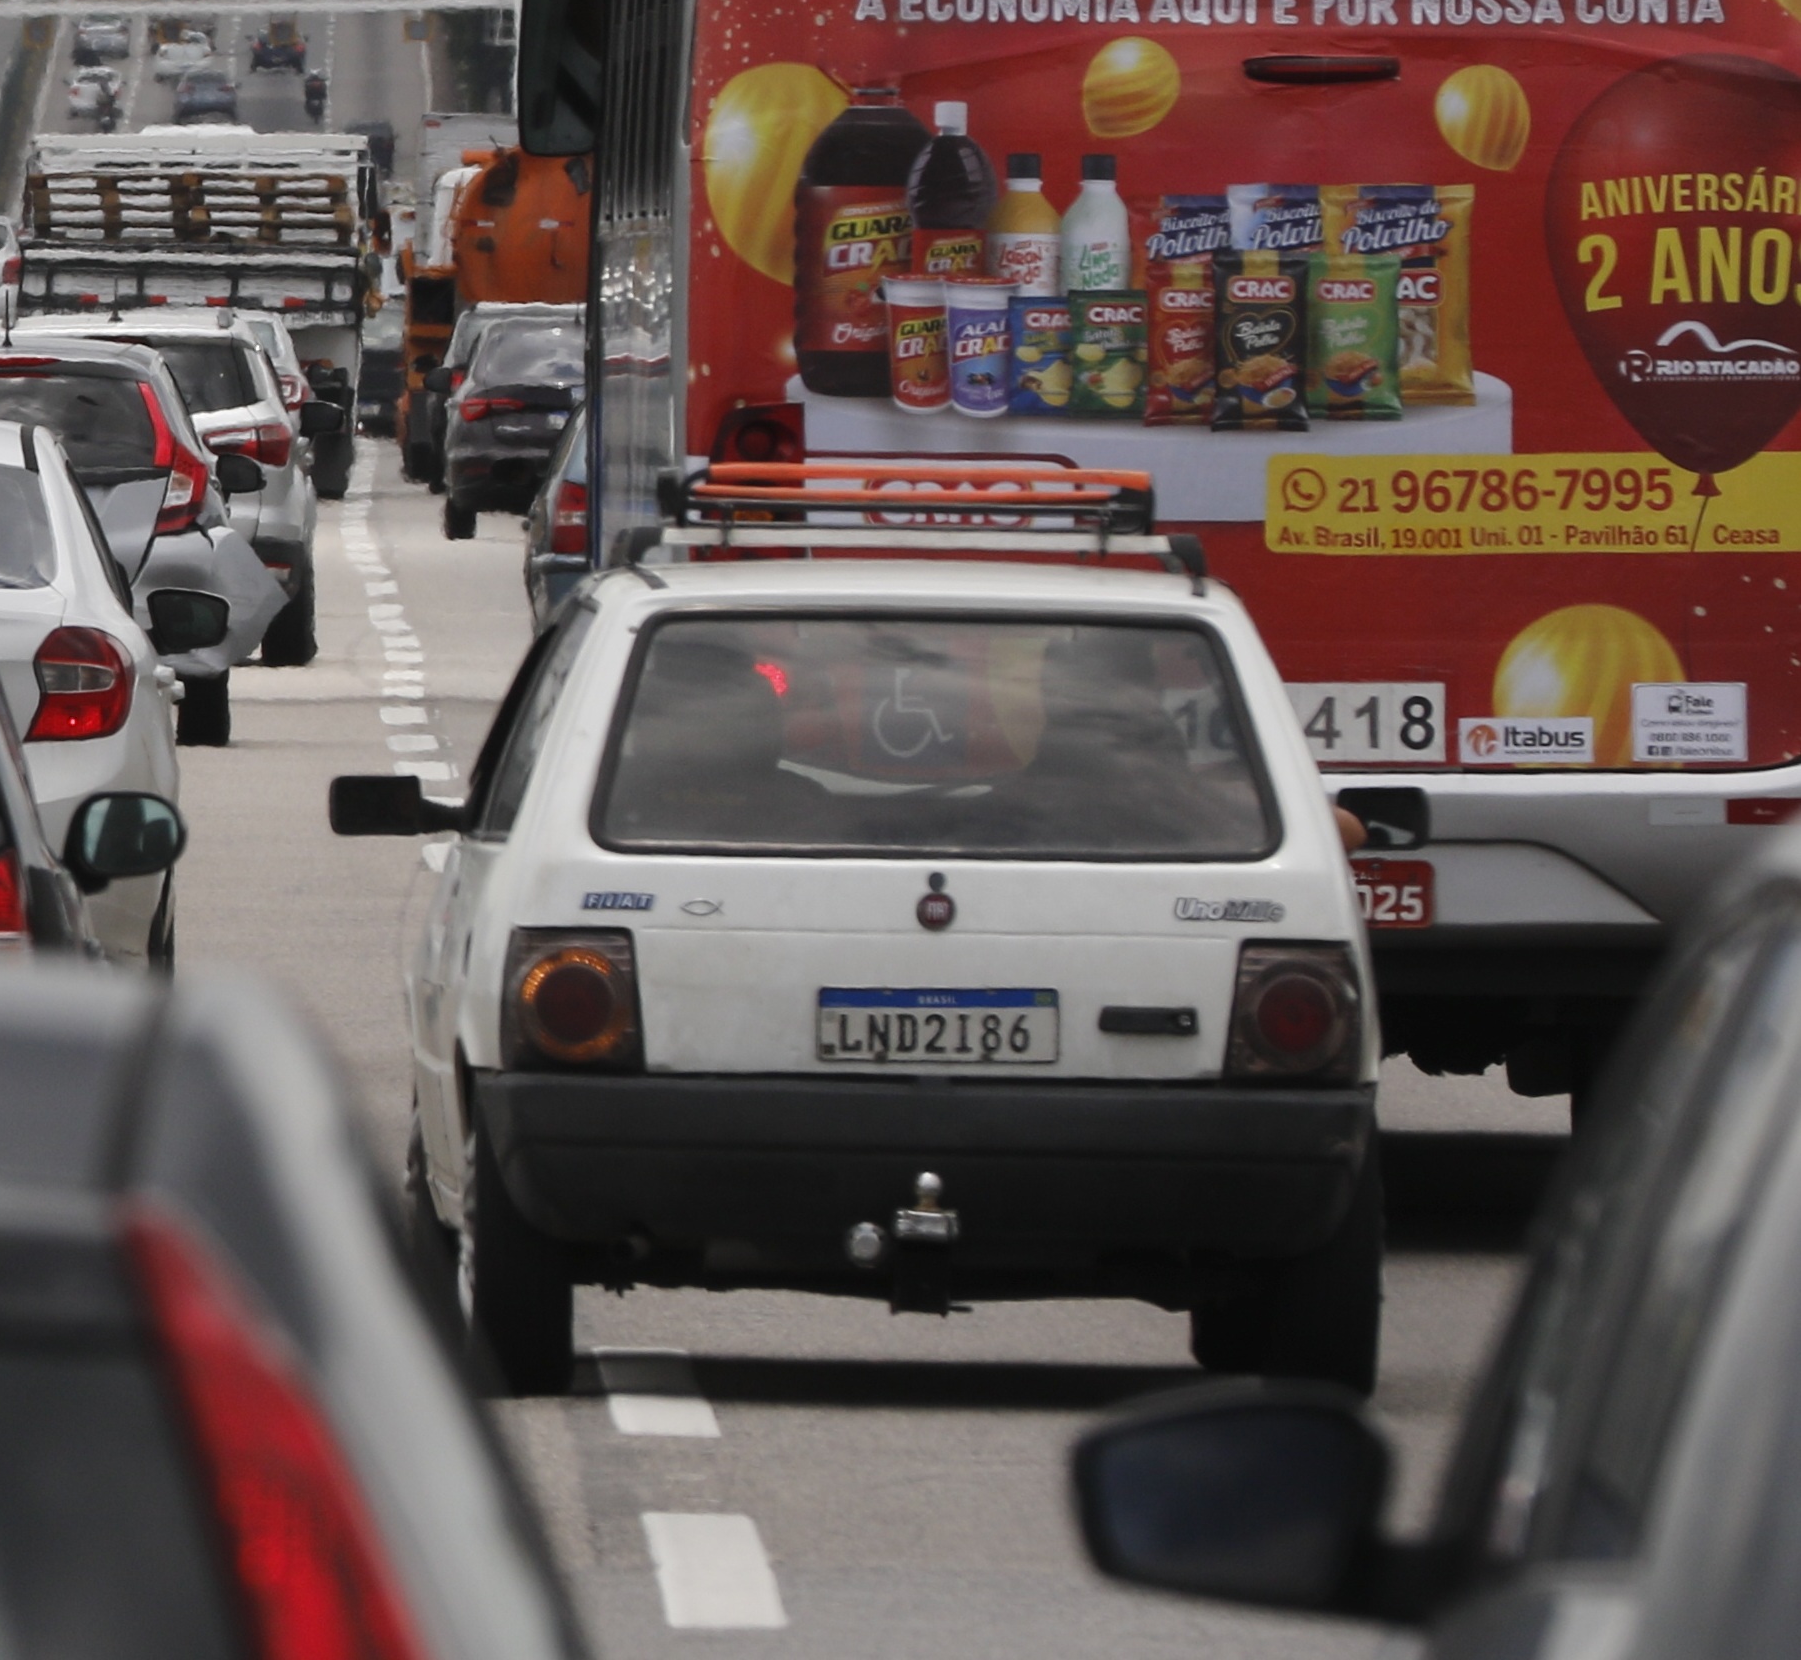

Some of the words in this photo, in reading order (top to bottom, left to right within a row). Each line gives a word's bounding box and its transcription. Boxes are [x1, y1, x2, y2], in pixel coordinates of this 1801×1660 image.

[1581, 167, 1801, 221] ANIVERSÁR
[1356, 204, 1418, 226] Biscoito
[1342, 214, 1453, 254] Polvilho
[1578, 234, 1623, 312] 2
[1650, 227, 1801, 306] ANO
[1164, 292, 1213, 308] CRAC
[1232, 280, 1290, 299] CRAC
[1319, 282, 1373, 300] CRAC
[1088, 307, 1144, 324] CRAC
[955, 336, 1009, 357] CRAC
[1338, 478, 1380, 513] 21
[1391, 468, 1674, 513] 96786-7995
[1277, 527, 1311, 547] Av.
[1315, 525, 1386, 550] Brasil,
[1391, 528, 1463, 549] 19.001
[1470, 526, 1513, 547] Uni.
[1517, 526, 1544, 546] 01
[1564, 524, 1659, 547] Pavilhão
[1663, 526, 1689, 546] 61
[1712, 525, 1780, 546] Ceasa
[1305, 695, 1435, 750] 418
[1504, 726, 1585, 747] Itabus
[584, 892, 653, 910] FIAT
[917, 994, 958, 1006] BRASIL
